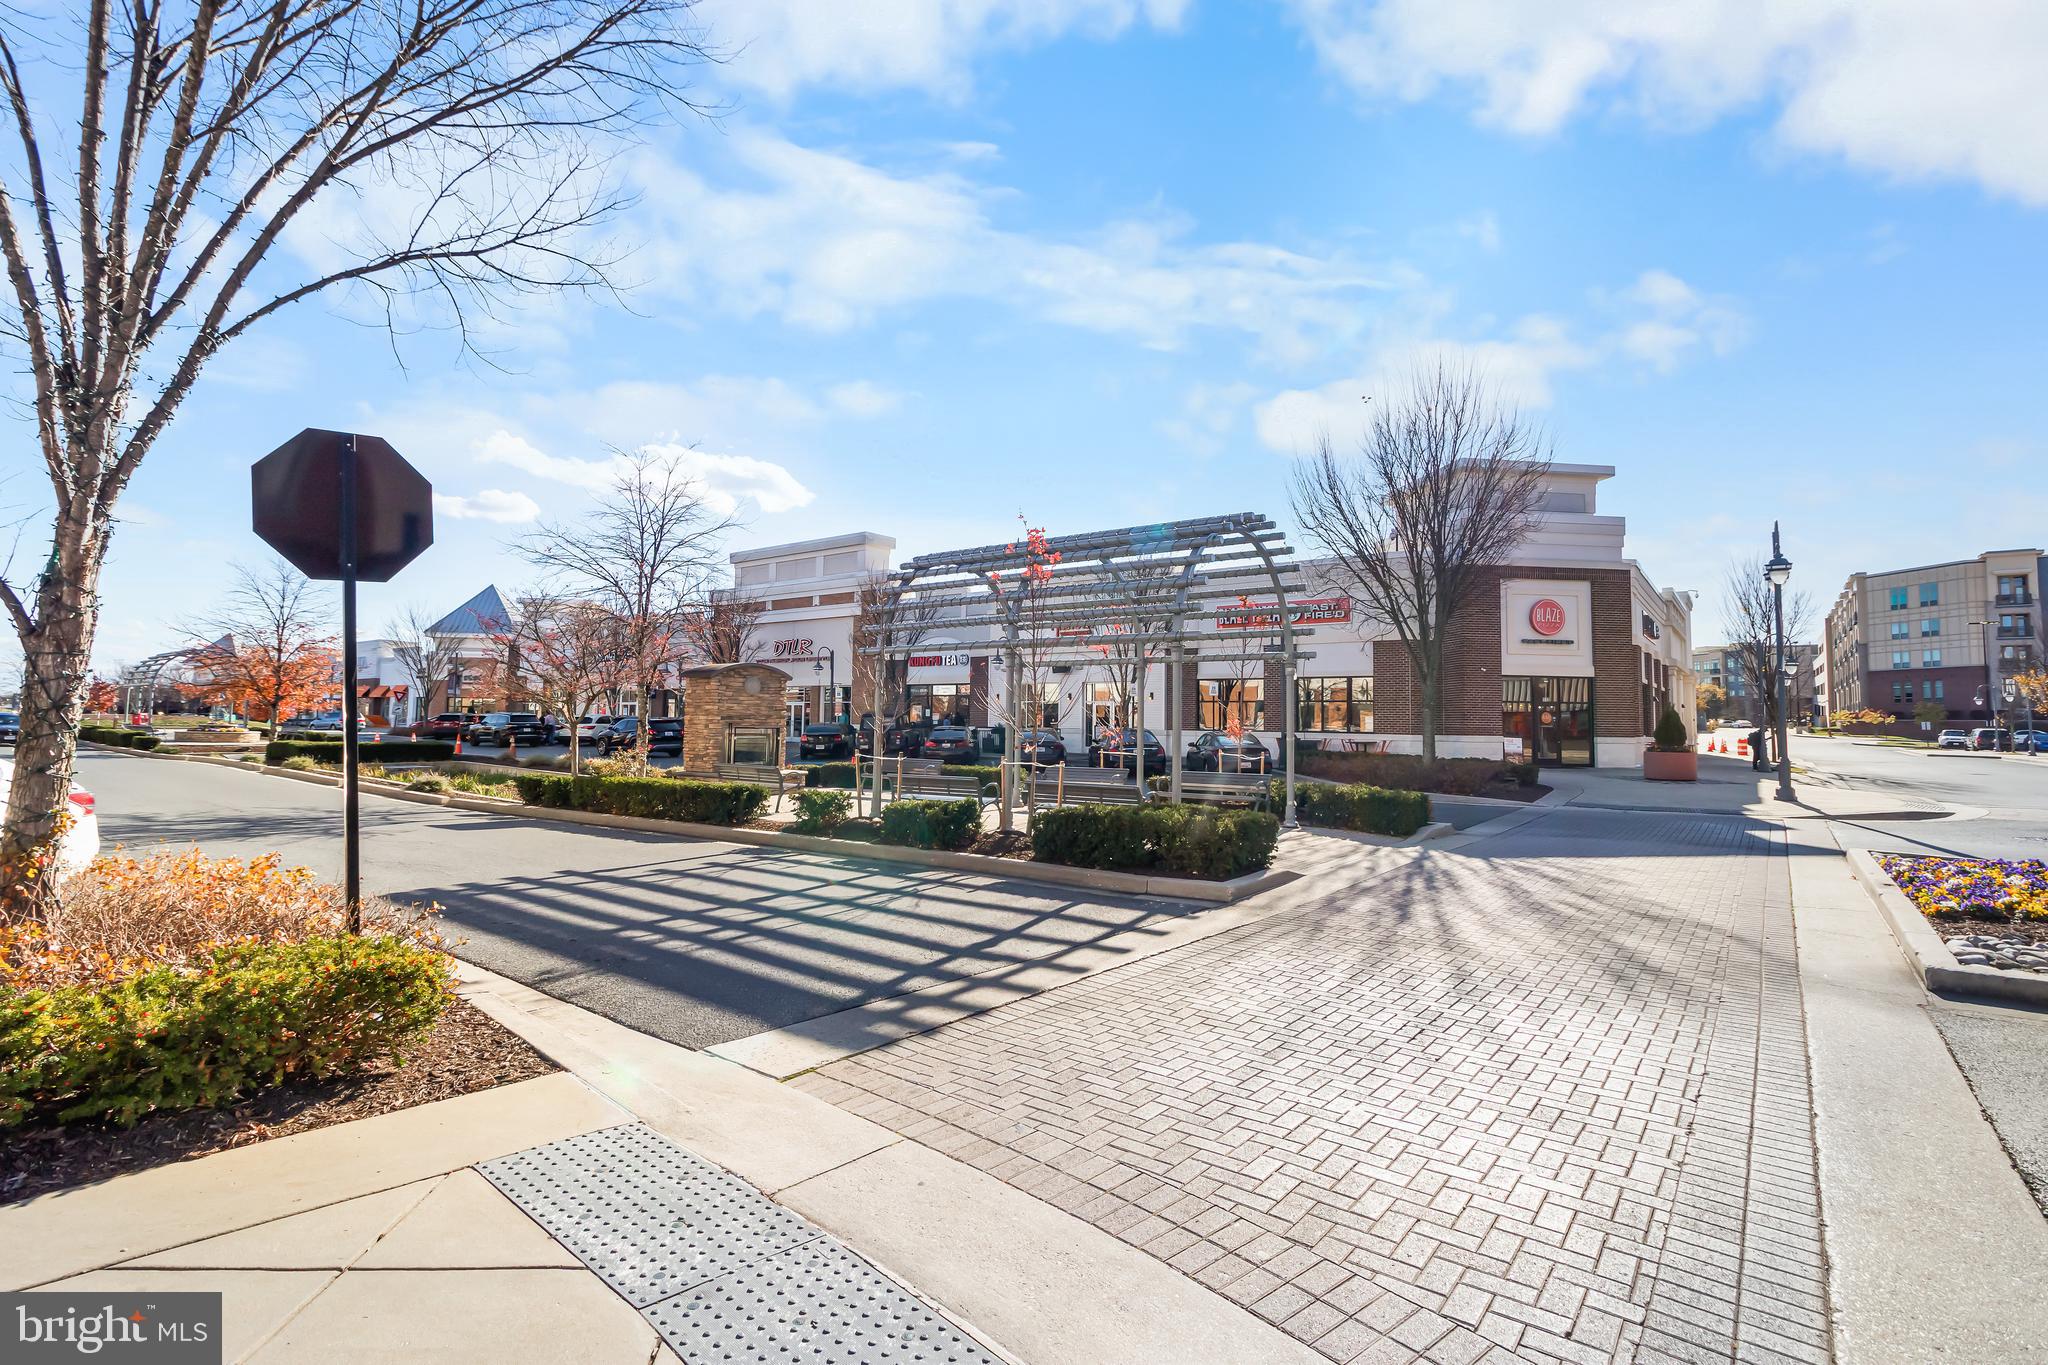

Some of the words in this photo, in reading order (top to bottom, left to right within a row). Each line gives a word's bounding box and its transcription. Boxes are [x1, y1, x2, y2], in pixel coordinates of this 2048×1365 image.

[1536, 608, 1561, 622] BLAZE
[773, 638, 813, 657] DTLR
[942, 654, 958, 666] TEA
